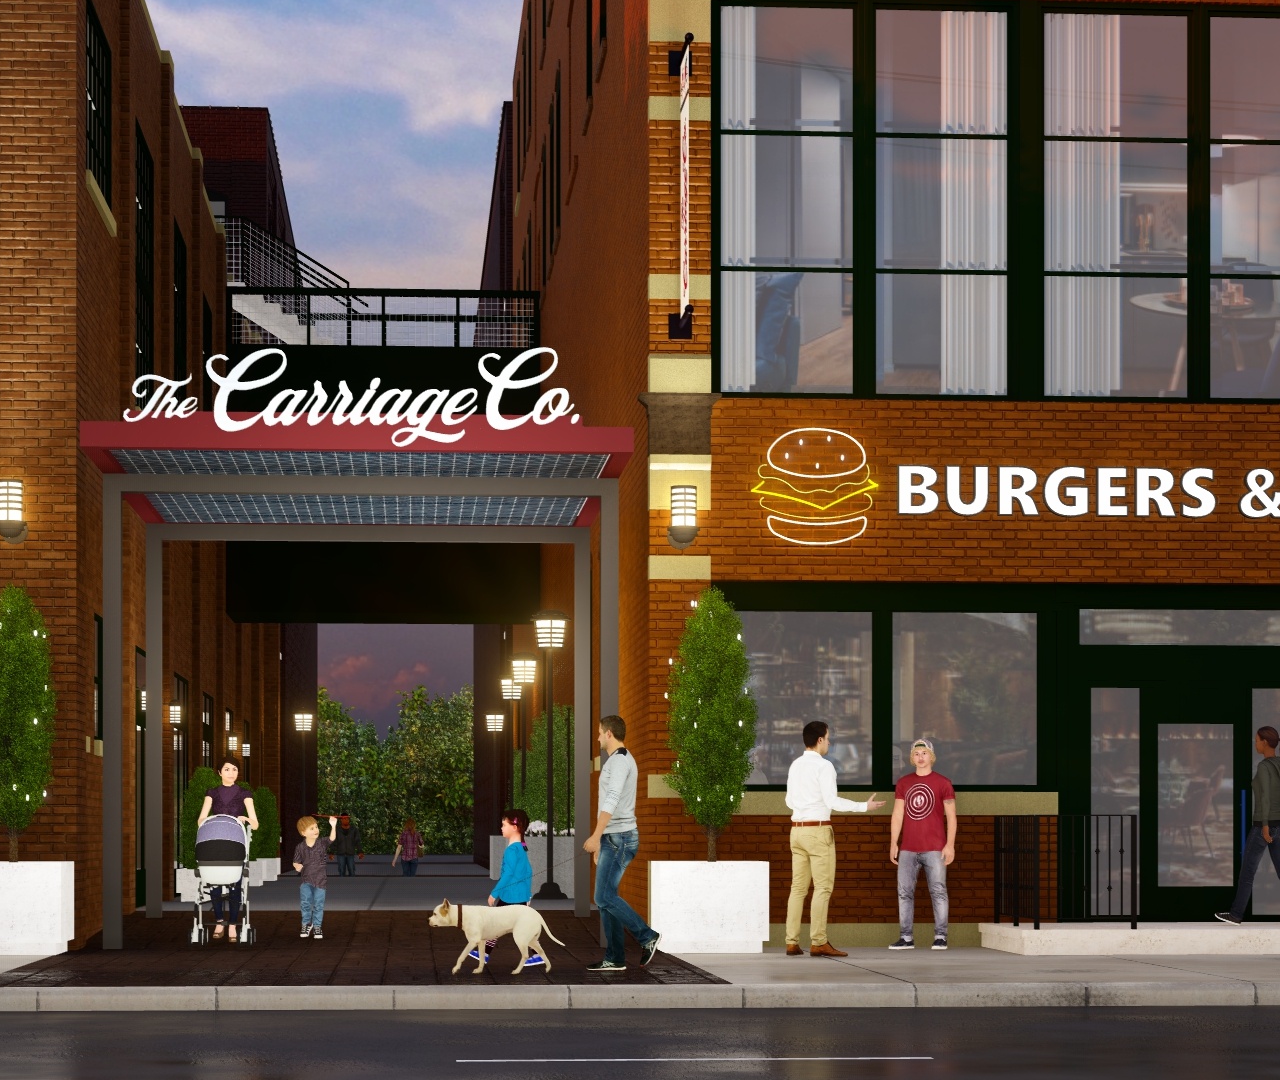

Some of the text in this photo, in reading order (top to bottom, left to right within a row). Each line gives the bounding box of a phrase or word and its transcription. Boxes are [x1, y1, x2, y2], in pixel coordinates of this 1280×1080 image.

[122, 347, 581, 447] The Carriage Co.
[897, 464, 1217, 519] BURGERS
